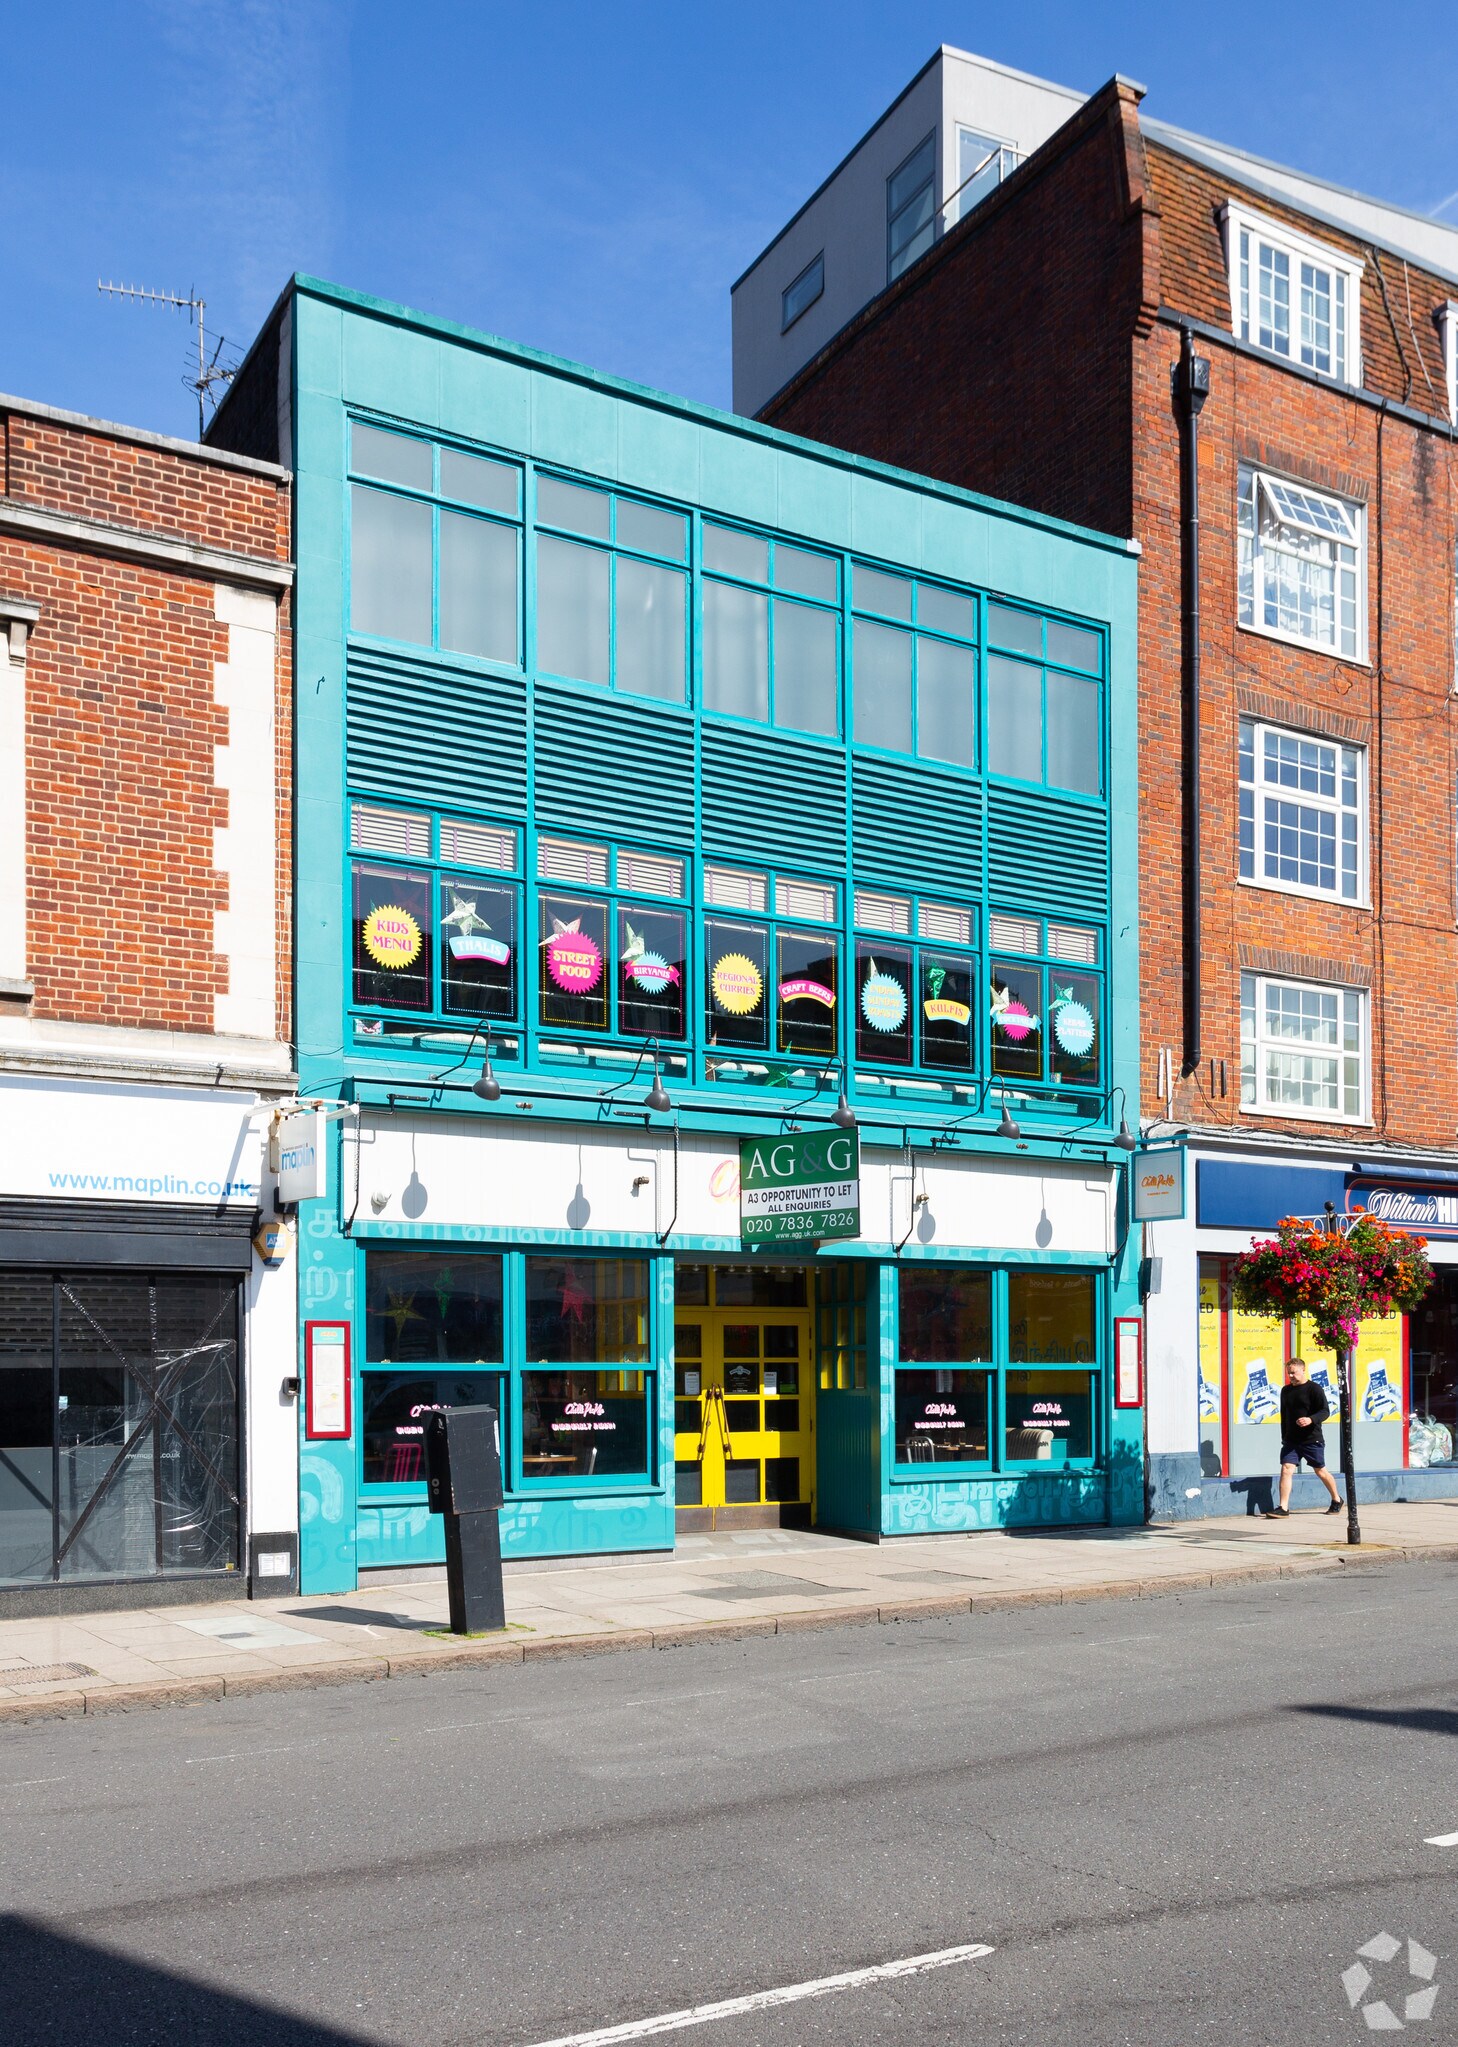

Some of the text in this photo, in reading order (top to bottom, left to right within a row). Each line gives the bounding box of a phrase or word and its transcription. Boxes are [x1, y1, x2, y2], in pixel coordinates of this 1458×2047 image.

[376, 919, 409, 935] KIDS
[372, 935, 412, 951] MENU
[456, 940, 501, 956] THALIS
[553, 949, 597, 966] STREET
[559, 964, 591, 979] FOOD
[633, 967, 671, 979] BIRYANIS
[717, 971, 758, 985] REGIONAL
[719, 983, 755, 996] CURRIES
[782, 983, 831, 1001] CRAFT BEERS
[867, 995, 901, 1008] SUNDAY
[930, 1003, 963, 1017] KULFIS
[281, 1144, 315, 1172] maplin
[48, 1173, 252, 1198] www.maplin.co.uk
[747, 1184, 852, 1205] A3 OPPORTUNITY TO LET
[767, 1200, 832, 1213] ALL ENQUIRIES
[1368, 1188, 1438, 1222] William
[746, 1212, 854, 1233] 020 7836 7826
[775, 1229, 826, 1239] www.agg.uk.com
